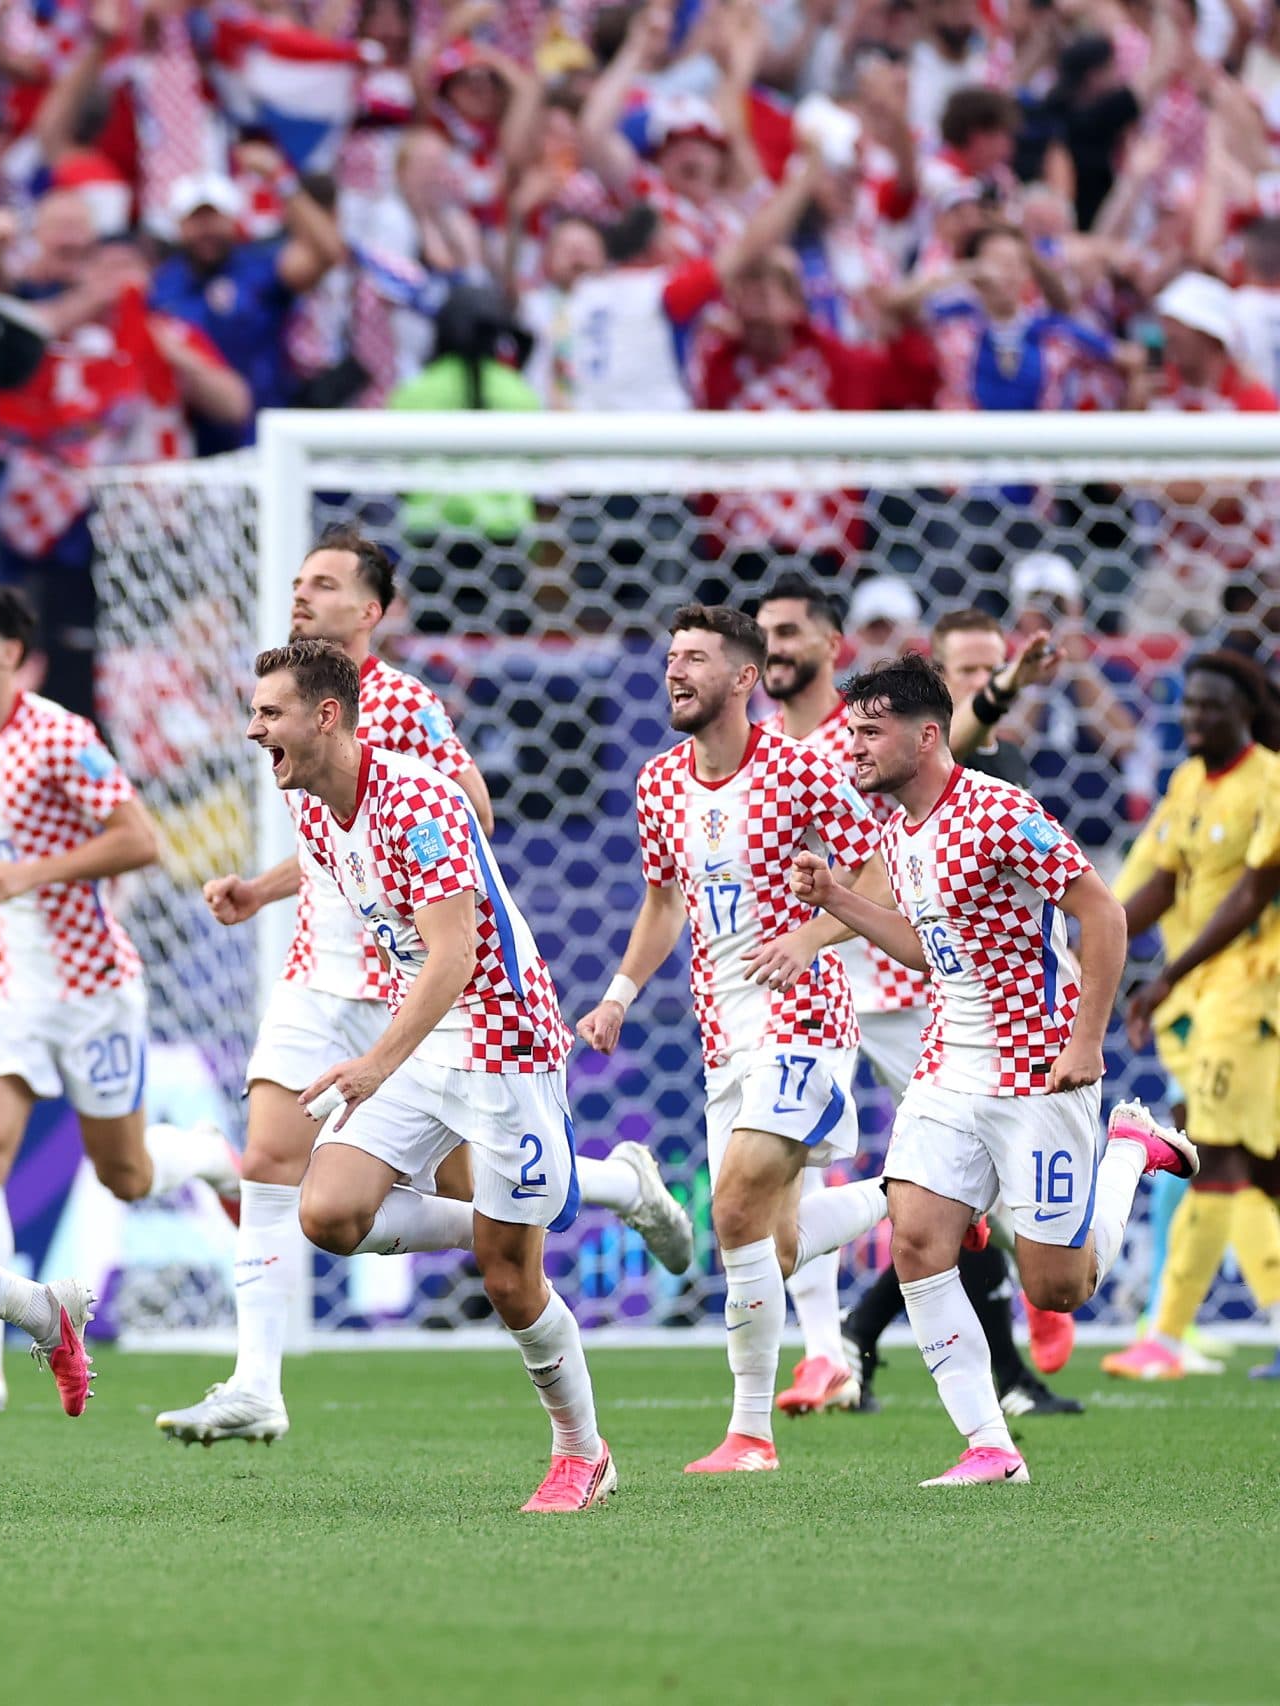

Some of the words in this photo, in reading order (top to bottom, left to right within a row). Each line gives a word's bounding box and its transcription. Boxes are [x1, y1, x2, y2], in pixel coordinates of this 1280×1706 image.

[704, 883, 742, 935] 17
[922, 926, 963, 976] 16
[85, 1032, 132, 1083] 20
[775, 1054, 817, 1101] 17
[519, 1133, 547, 1187] 2
[1031, 1150, 1074, 1204] 16
